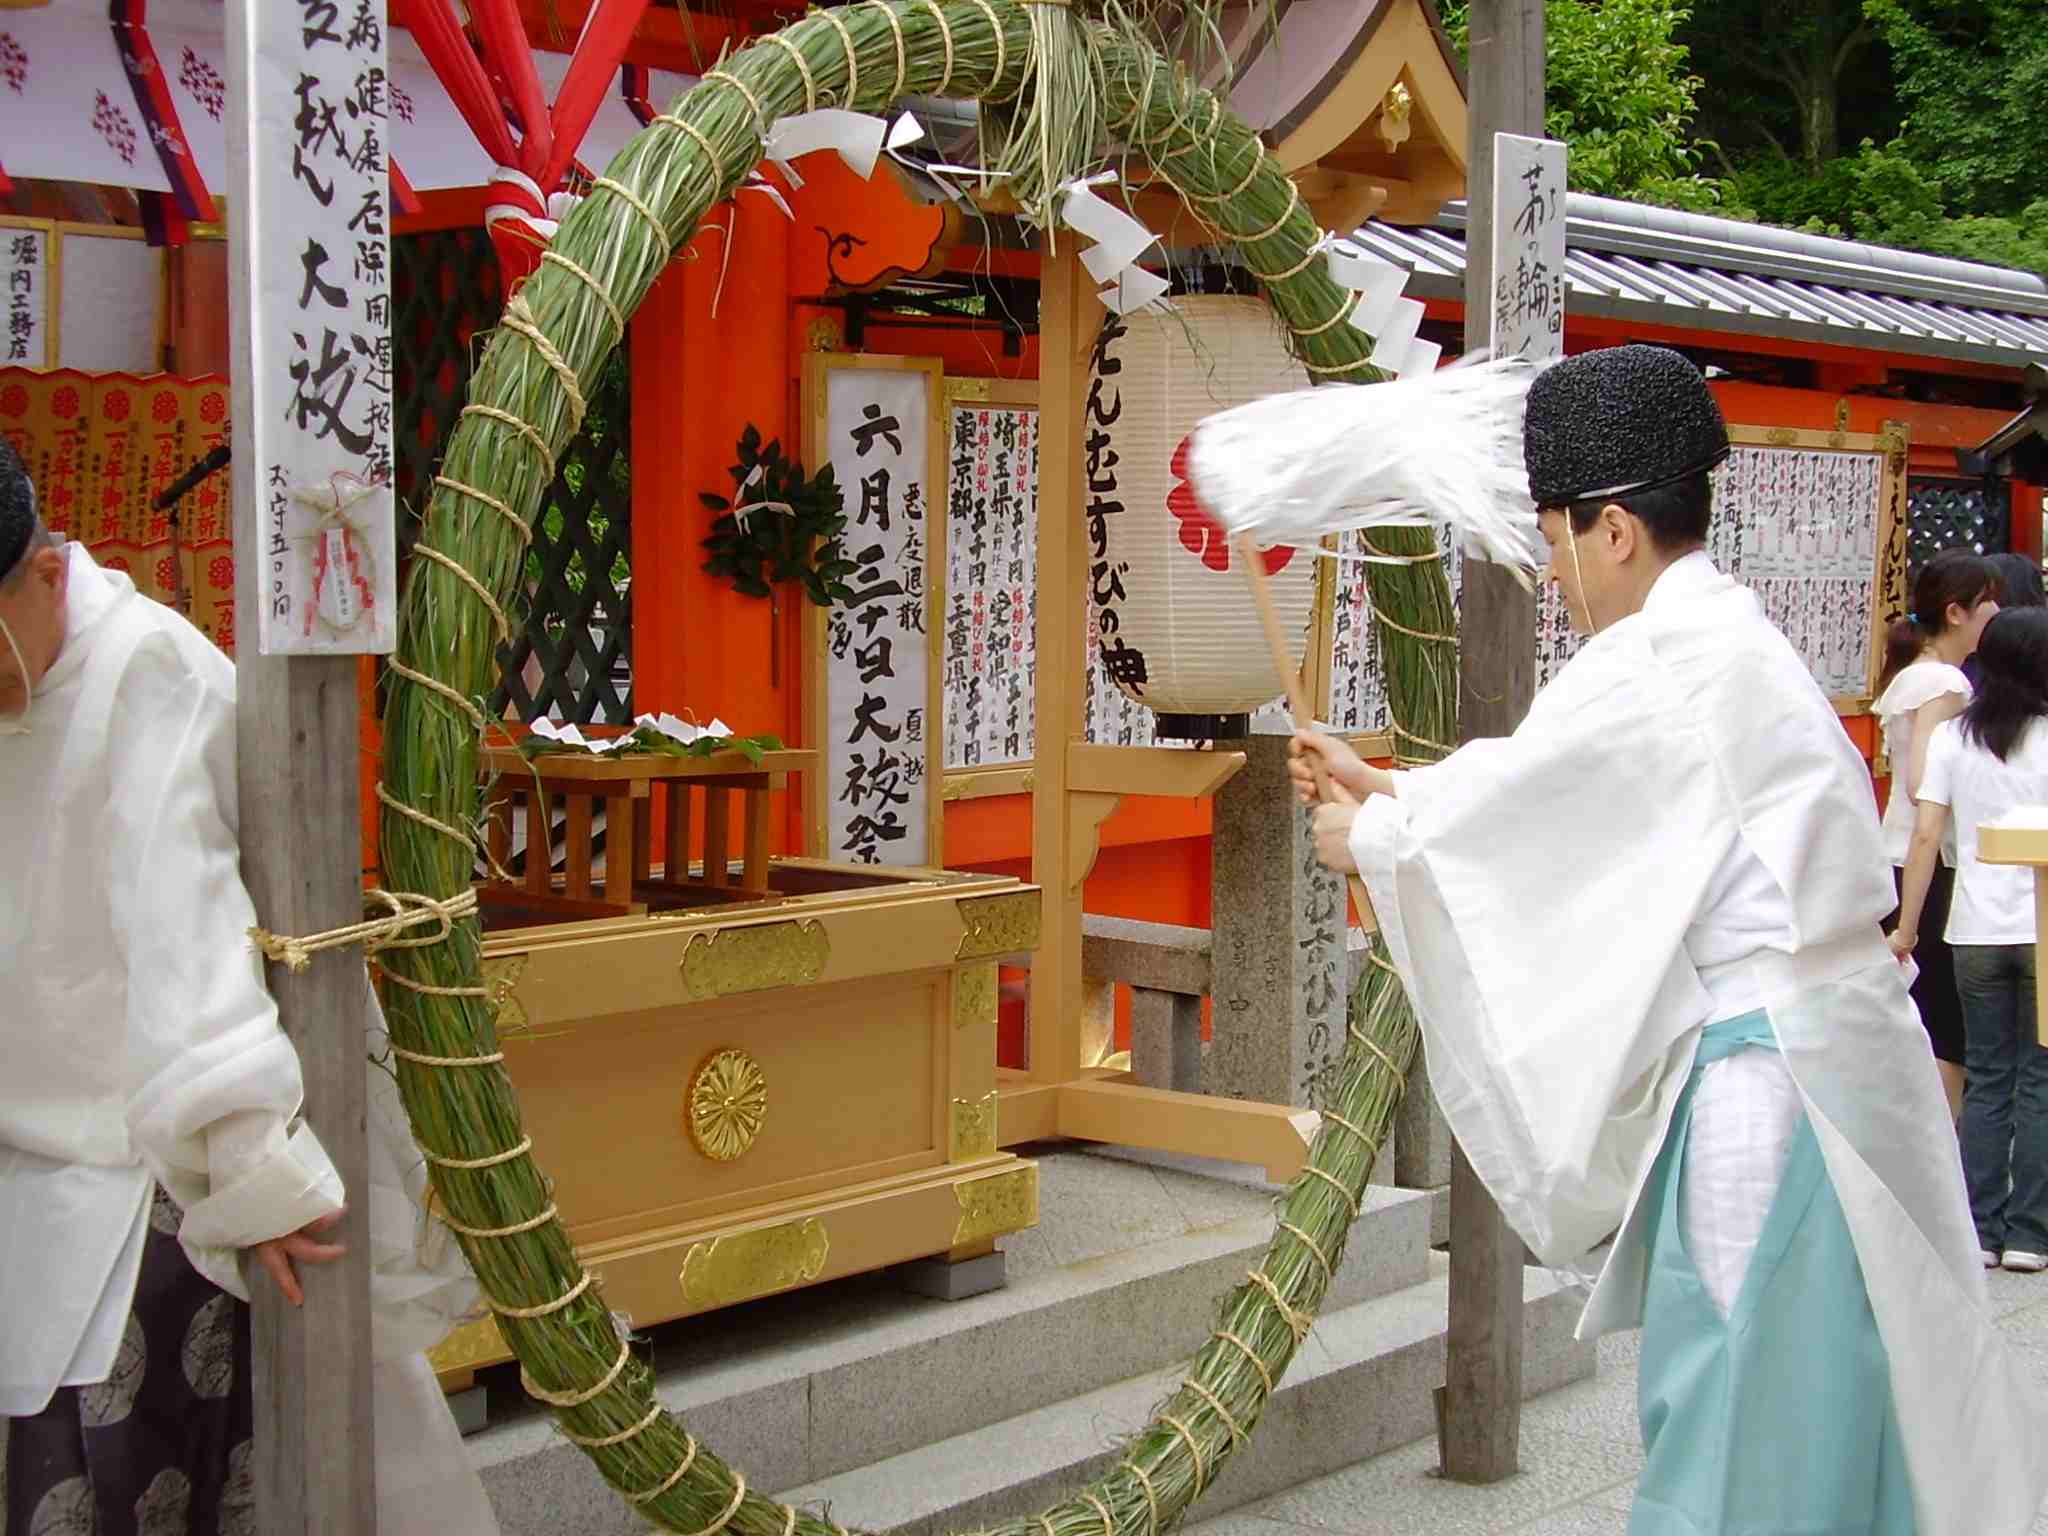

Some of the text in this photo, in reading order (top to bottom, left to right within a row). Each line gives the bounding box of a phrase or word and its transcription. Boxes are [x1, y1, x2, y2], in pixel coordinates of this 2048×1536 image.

[950, 411, 977, 520] 東京都
[990, 411, 1018, 519] 埼玉県
[895, 482, 926, 634] 悪疫退散
[967, 497, 988, 586] 五千円
[1007, 497, 1025, 583] 五千円
[839, 403, 910, 864] 六月三十日大祓祭
[945, 592, 971, 693] 三重県
[986, 589, 1012, 692] 愛知県
[1333, 586, 1353, 668] 水戸市
[901, 708, 926, 785] 夏越
[964, 676, 982, 765] 五千円
[1005, 672, 1021, 757] 五千円
